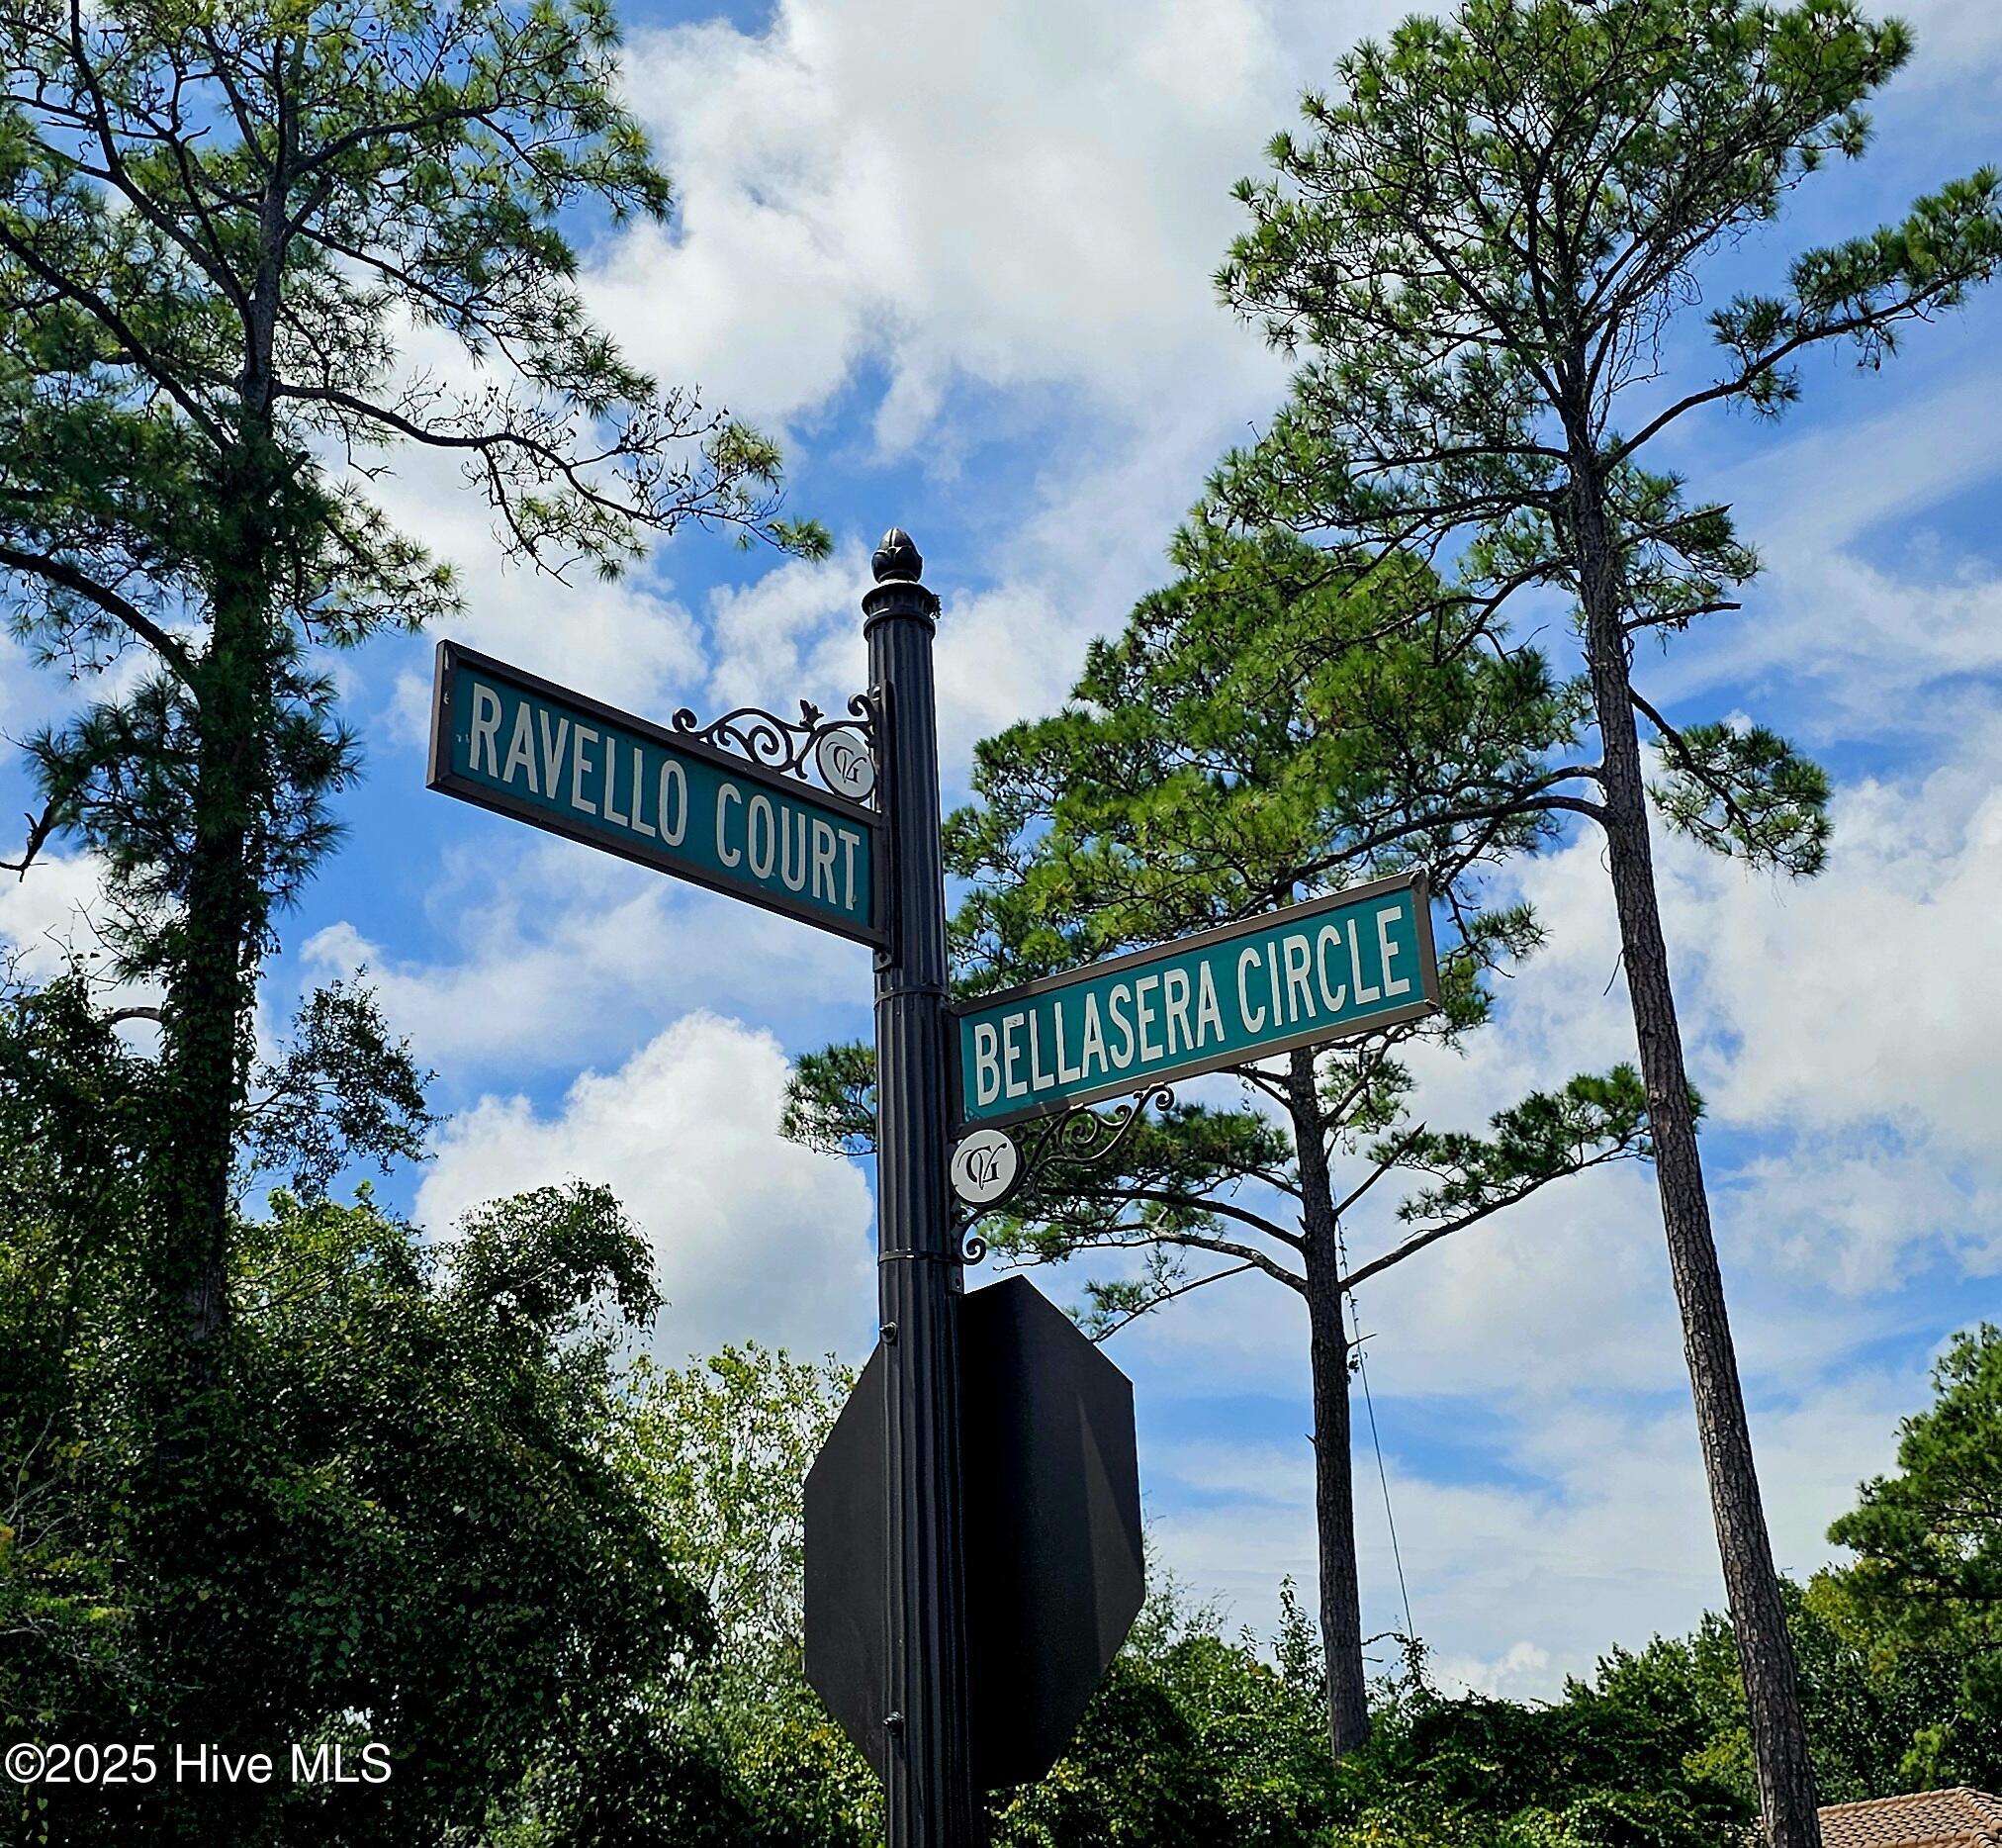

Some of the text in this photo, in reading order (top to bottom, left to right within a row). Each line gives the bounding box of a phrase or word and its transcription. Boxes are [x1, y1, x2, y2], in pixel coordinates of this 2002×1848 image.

[469, 683, 860, 911] RAVELLO COURT
[974, 906, 1410, 1106] BELLASERA CIRCLE
